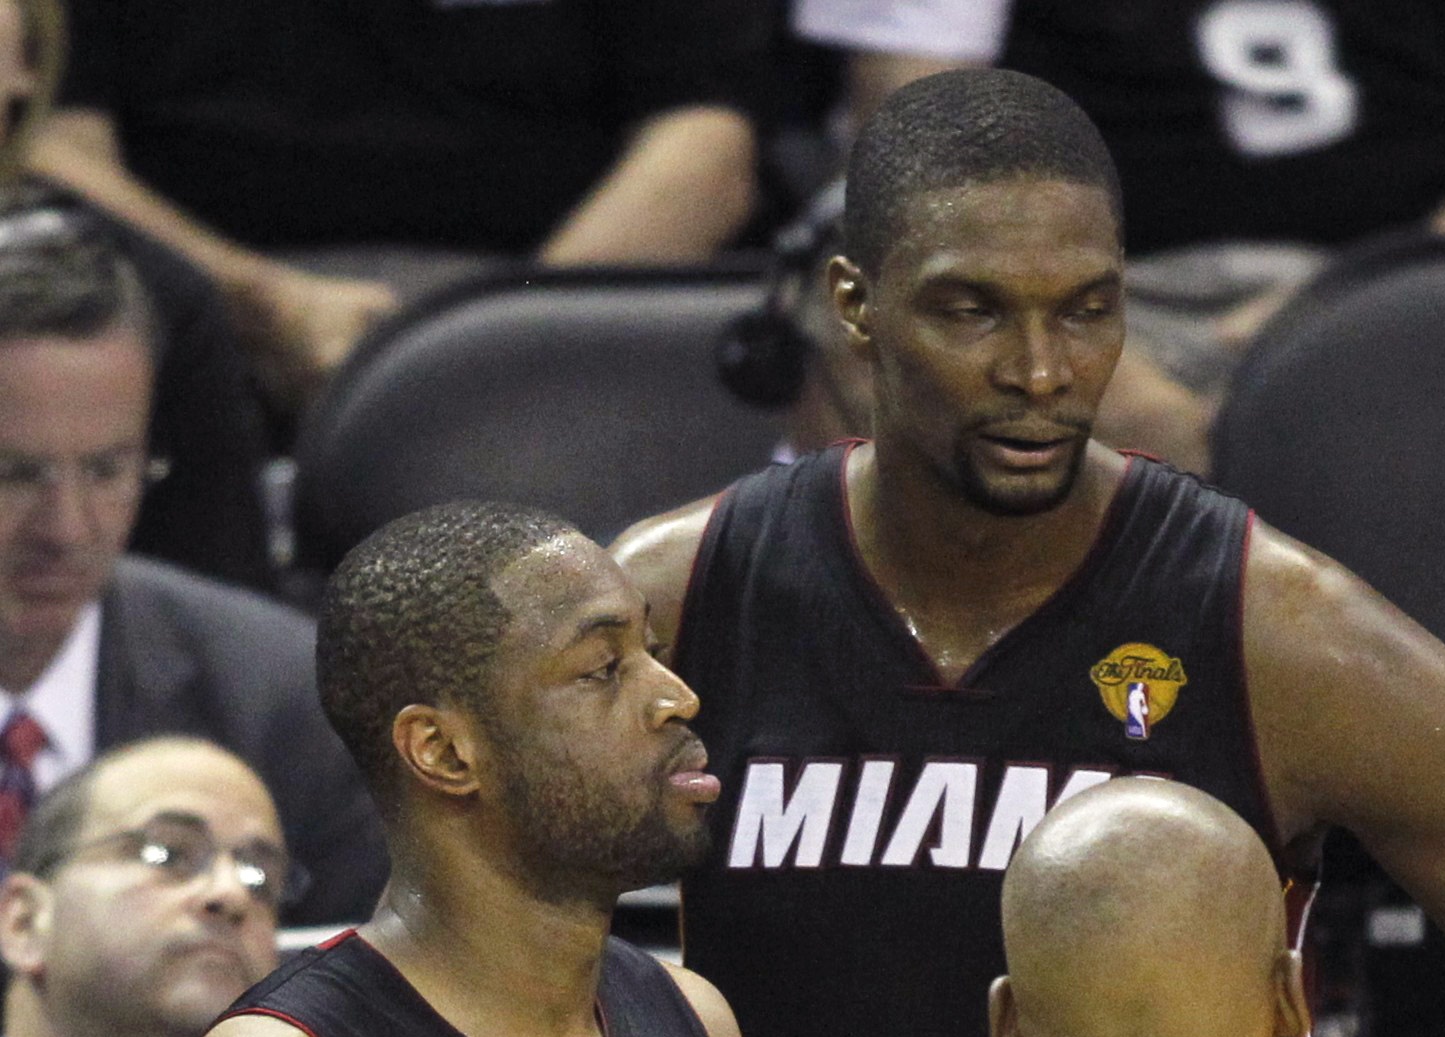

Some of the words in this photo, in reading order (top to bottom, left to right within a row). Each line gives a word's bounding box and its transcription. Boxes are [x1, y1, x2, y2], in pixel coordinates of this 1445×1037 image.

[1195, 0, 1358, 156] 9
[1119, 655, 1182, 685] Finals
[726, 756, 1172, 870] MIAM
